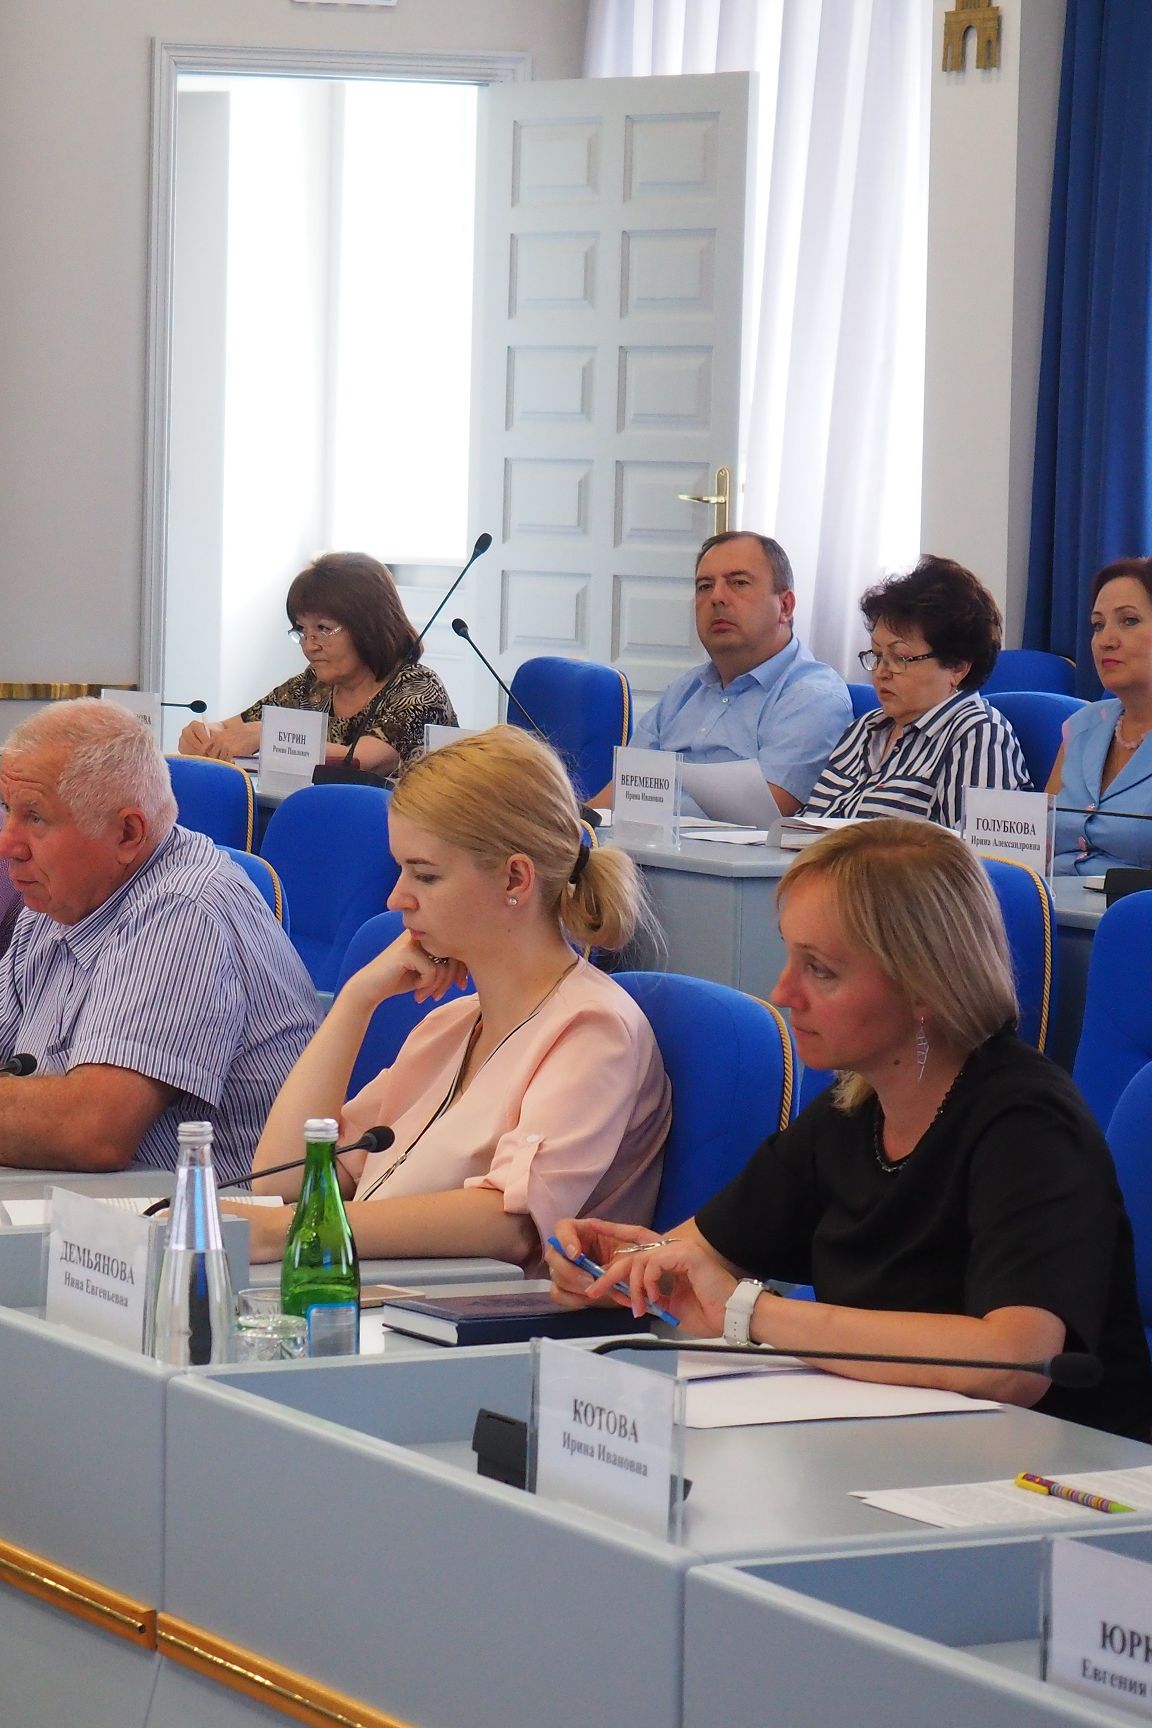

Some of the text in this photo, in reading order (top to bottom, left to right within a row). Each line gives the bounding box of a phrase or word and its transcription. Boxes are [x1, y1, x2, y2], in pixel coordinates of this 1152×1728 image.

[278, 731, 307, 745] БУГРИН
[621, 774, 670, 791] ВЕРЕМЕЕНКО
[971, 835, 1041, 852] Ирина Александровна
[976, 817, 1036, 836] ГОЛУБКОВА
[60, 1240, 135, 1285] ДЕМЬЯНОВА
[64, 1271, 129, 1307] Нина Евгеньевна
[573, 1398, 639, 1443] КОТОВА
[562, 1431, 648, 1478] Ирина Ивановна
[1081, 1658, 1147, 1697] Евгения
